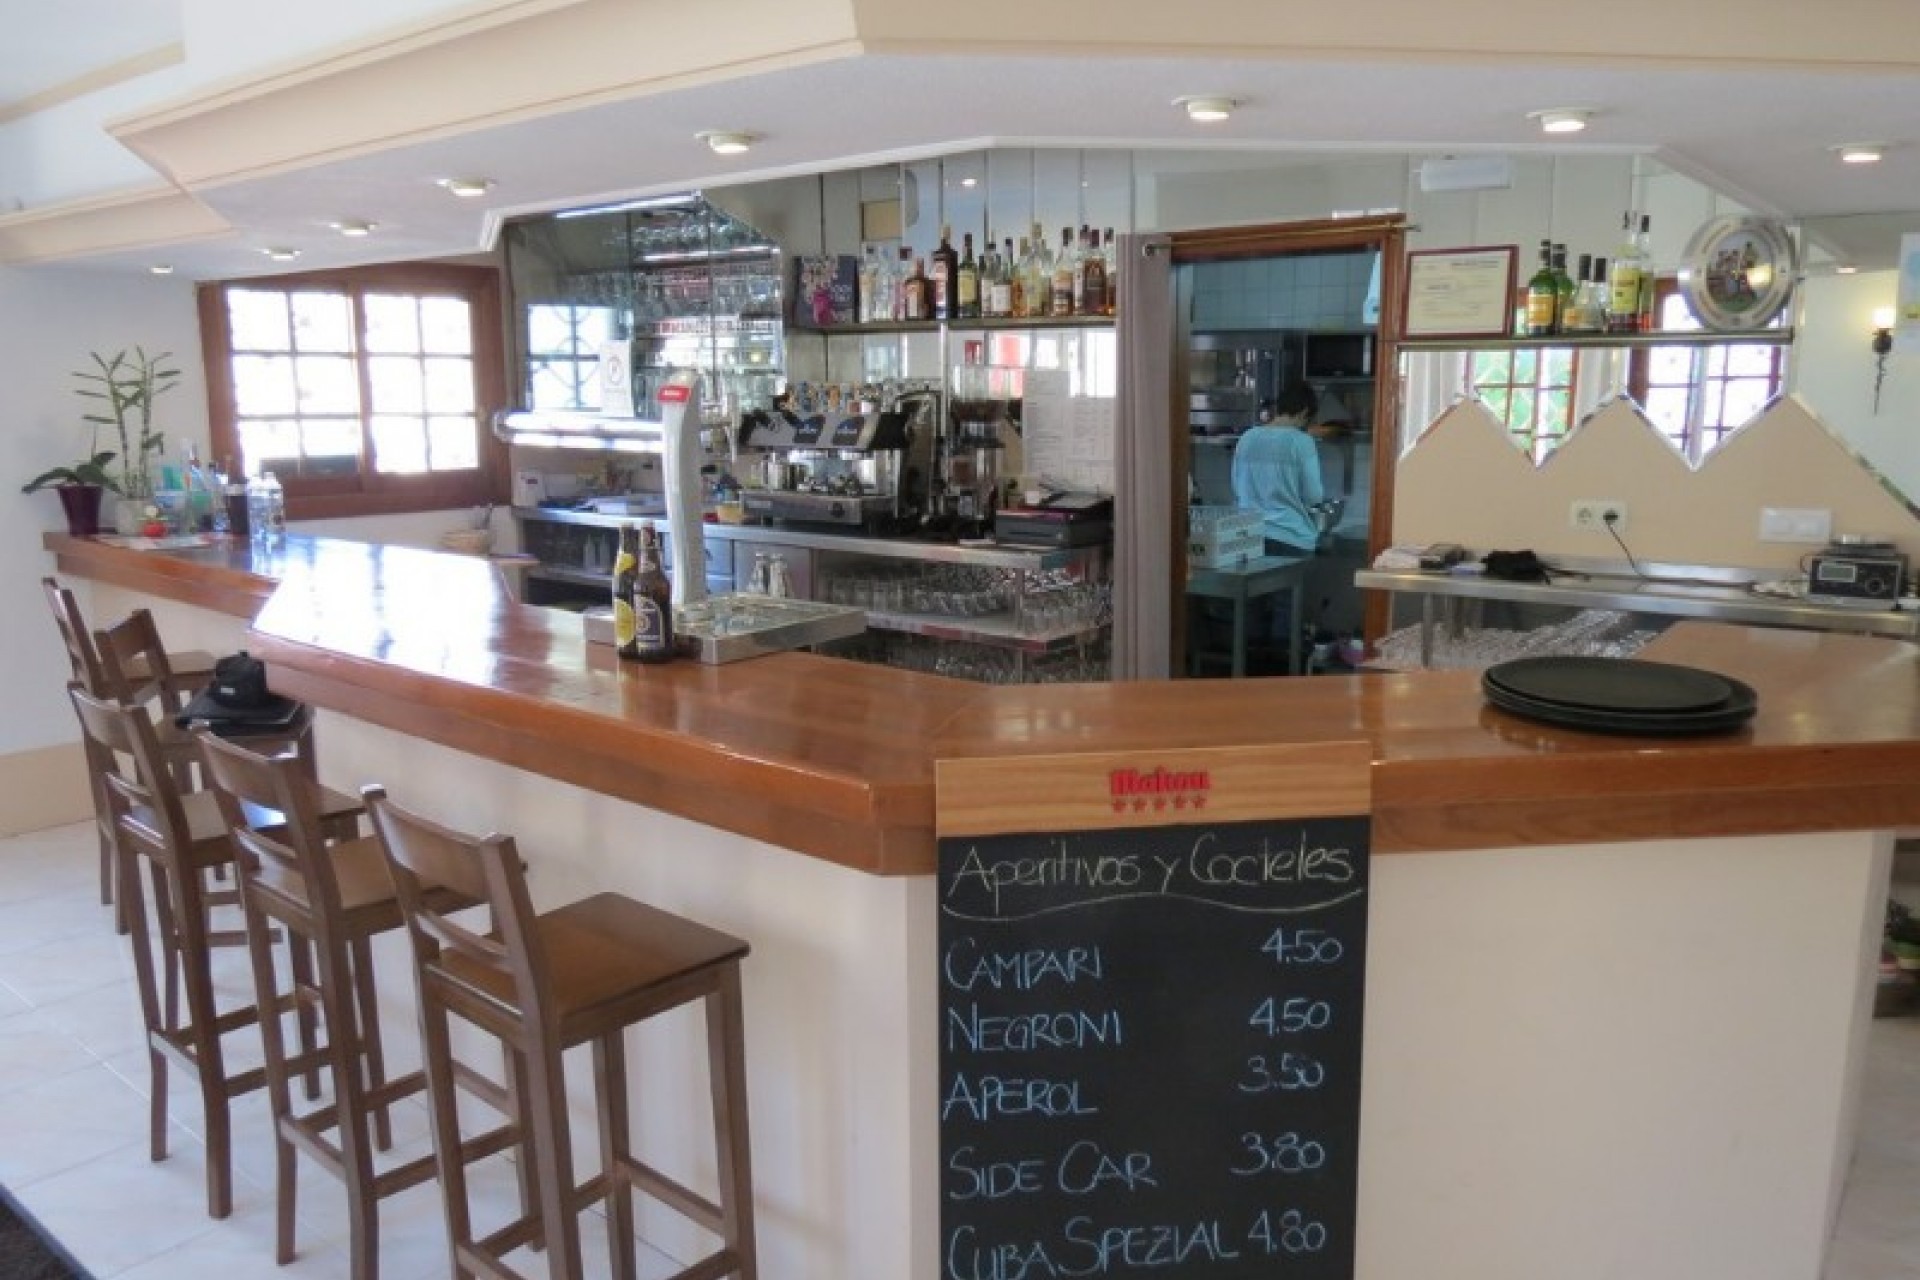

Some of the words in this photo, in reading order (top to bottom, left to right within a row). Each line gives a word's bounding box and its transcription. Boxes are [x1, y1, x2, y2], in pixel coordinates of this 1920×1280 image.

[948, 837, 1140, 916] Aperitivos
[1154, 855, 1182, 894] y
[945, 937, 1103, 990] CAMPARI
[1260, 927, 1343, 965] 4.50
[947, 1002, 1122, 1052] NEGRONI
[1248, 997, 1331, 1036] 4.50
[942, 1073, 1098, 1121] APEROL
[1238, 1053, 1324, 1092] 3.50
[948, 1145, 1044, 1200] SIDE
[1057, 1140, 1158, 1194] CAR
[1230, 1131, 1326, 1175] 3.80
[1058, 1215, 1239, 1276] SPEZIAL
[1247, 1208, 1326, 1254] 4.80
